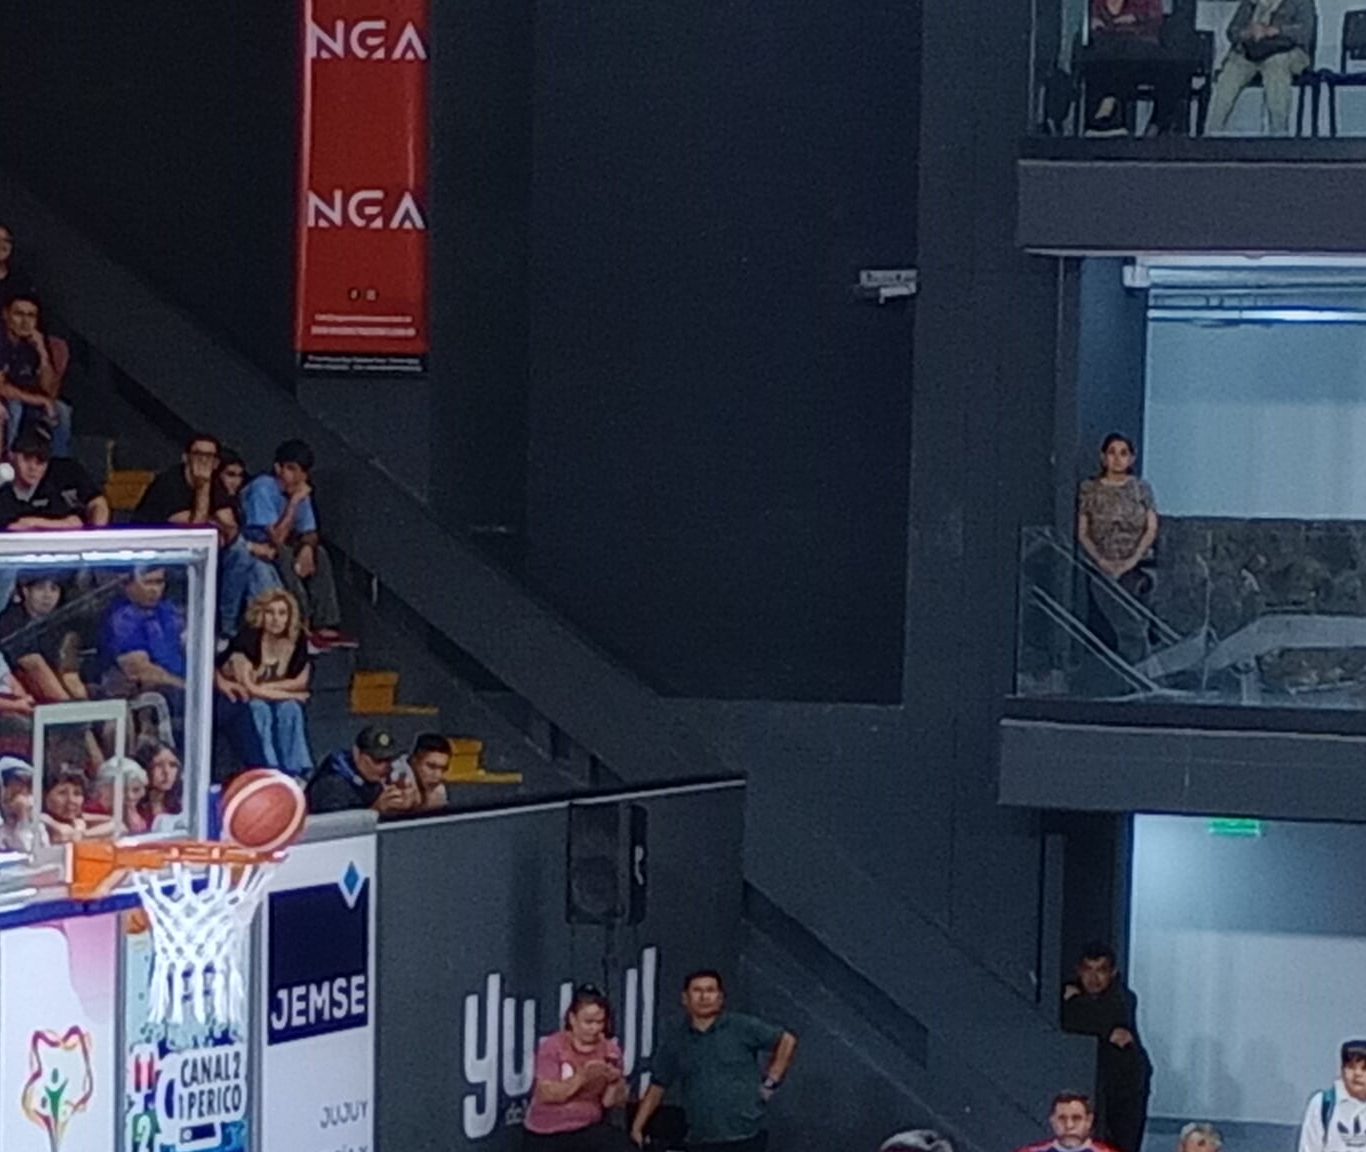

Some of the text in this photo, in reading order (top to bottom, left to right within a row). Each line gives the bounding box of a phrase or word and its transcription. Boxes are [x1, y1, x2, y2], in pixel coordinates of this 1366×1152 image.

[310, 19, 427, 60] NGA
[307, 189, 426, 229] NGA
[270, 974, 366, 1031] JEMSE
[181, 1053, 230, 1089] CANAL
[188, 1083, 243, 1120] PERICO
[319, 1101, 369, 1129] JUJUY
